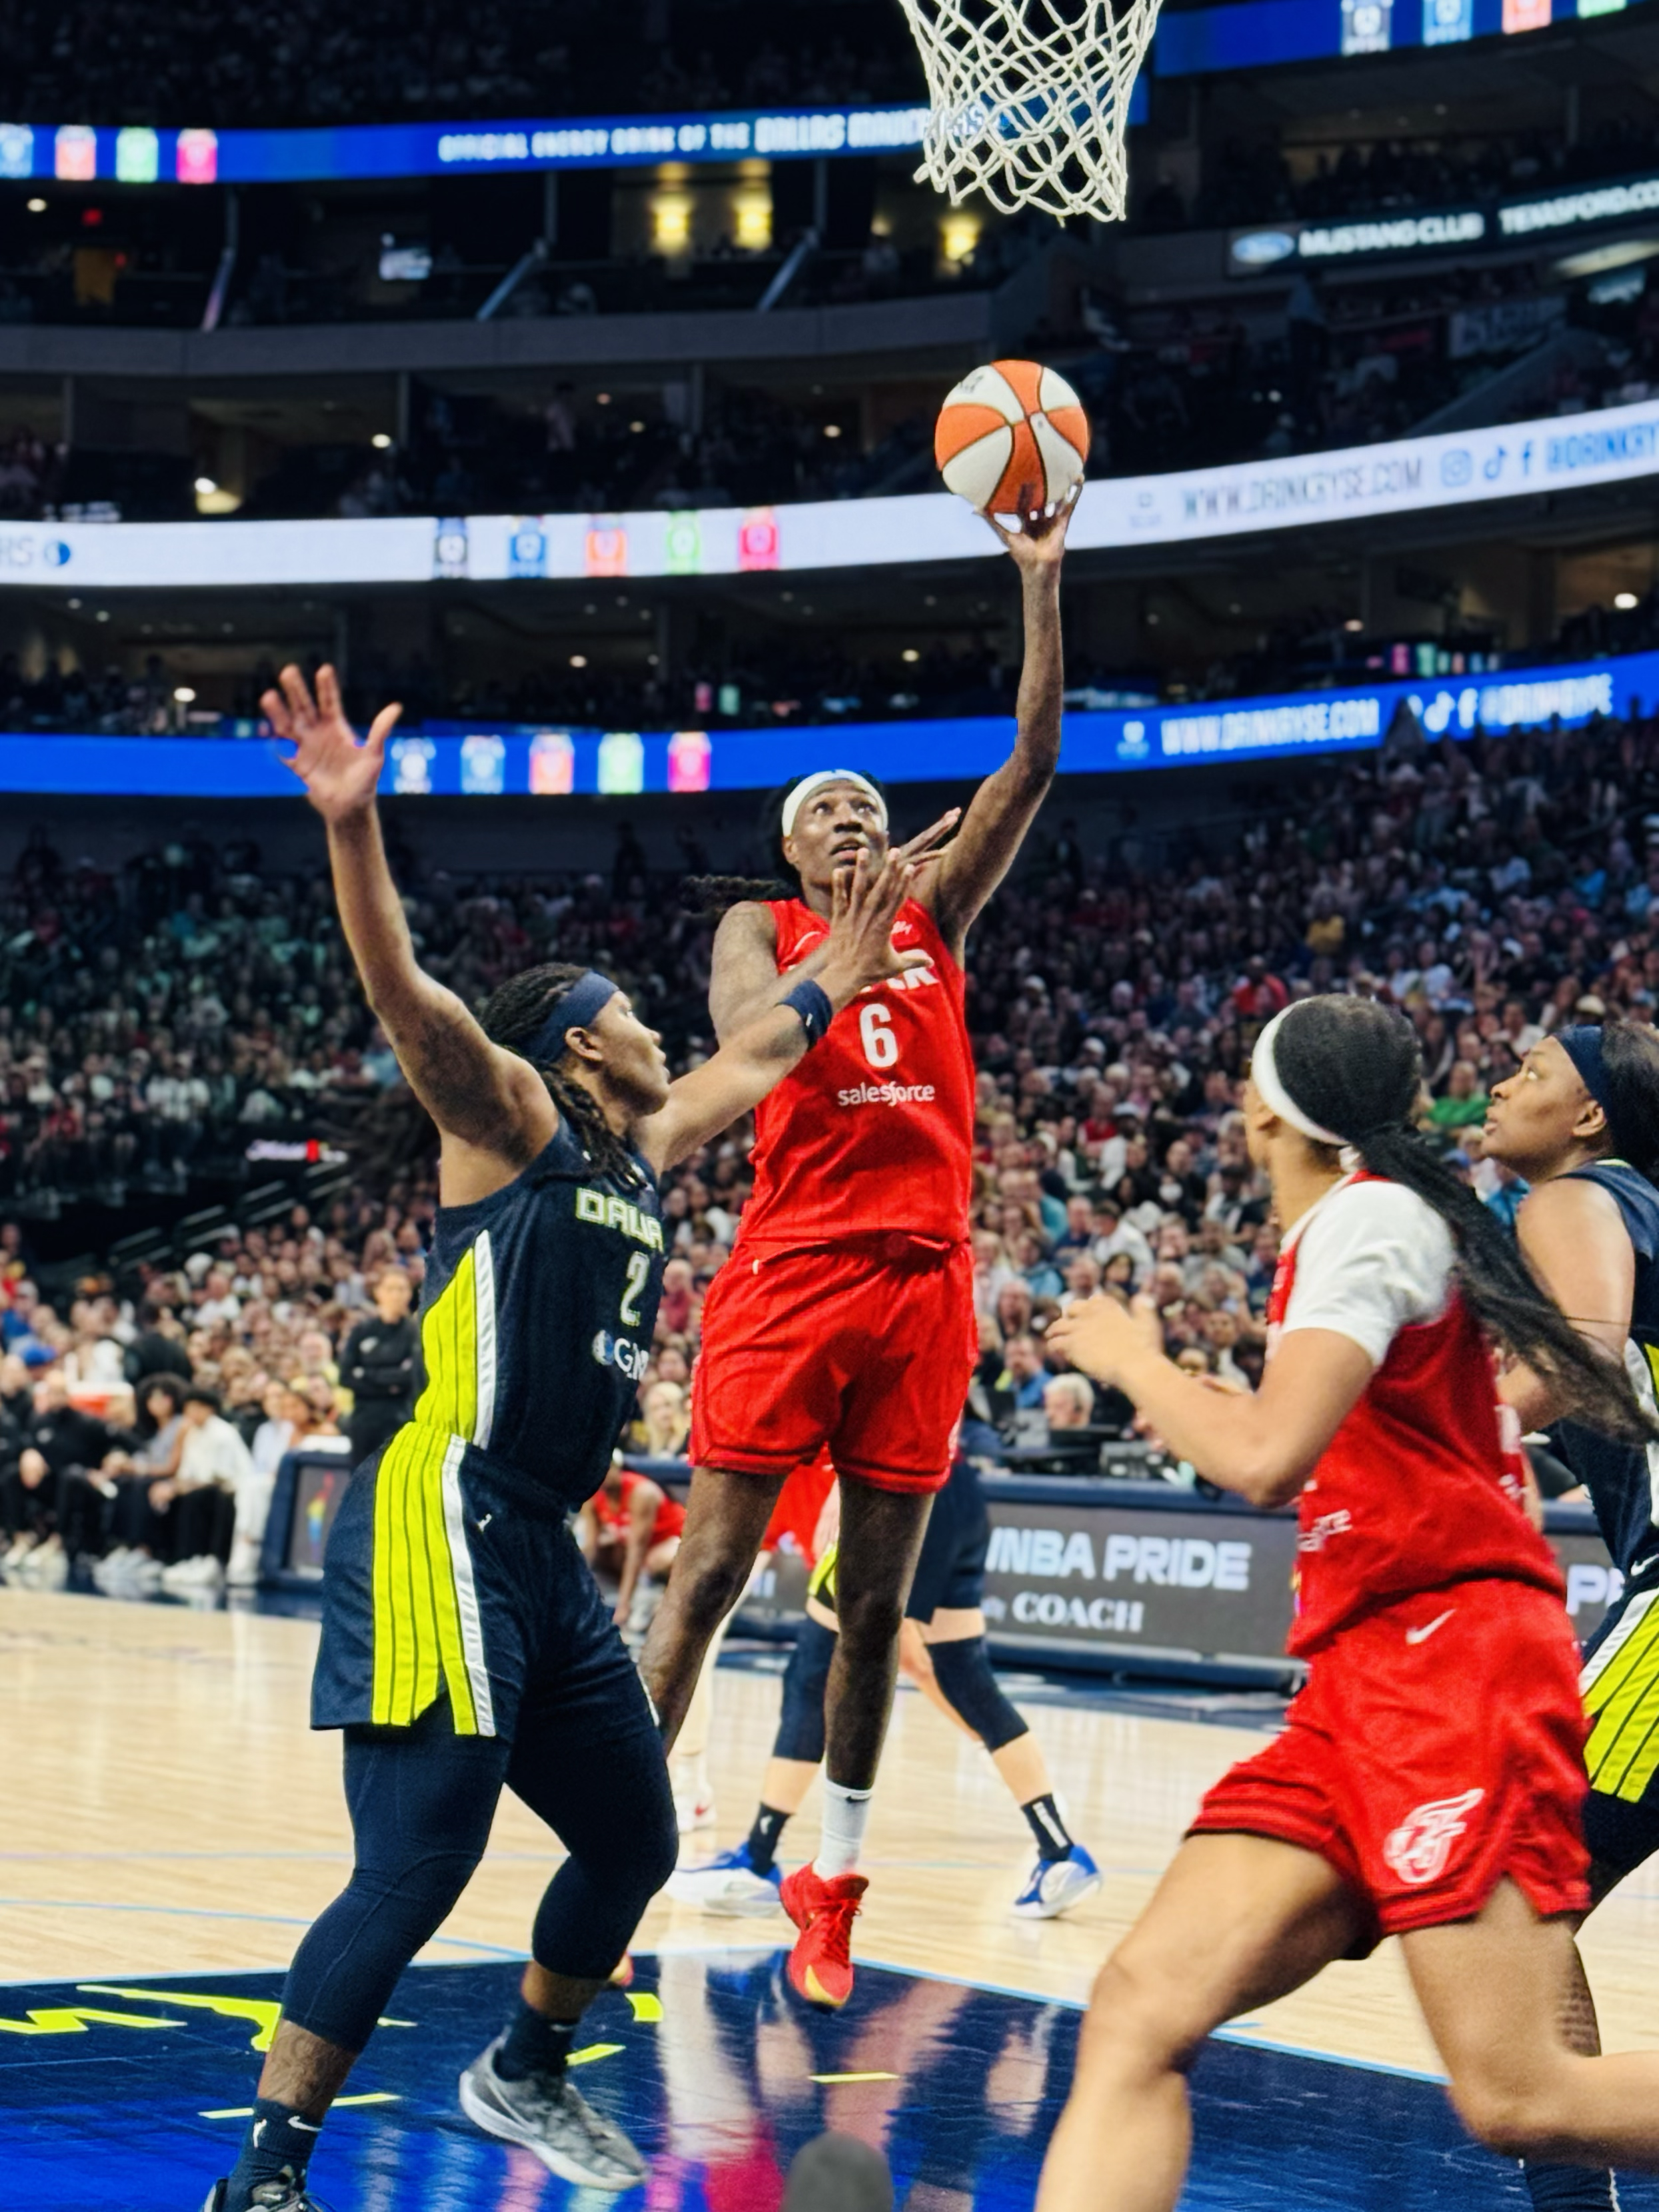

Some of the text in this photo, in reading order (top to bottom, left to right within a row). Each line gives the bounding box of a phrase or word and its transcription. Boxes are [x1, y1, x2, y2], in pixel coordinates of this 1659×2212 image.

[678, 124, 706, 151] OF
[710, 122, 750, 149] THE
[1299, 218, 1418, 256] MUSTANG
[1417, 212, 1485, 244] CLUB
[860, 1003, 898, 1068] 6
[837, 1081, 936, 1107] salesforce
[621, 1251, 651, 1327] 2
[984, 1527, 1096, 1580] NBA
[1102, 1534, 1252, 1591] PRIDE
[1012, 1591, 1144, 1633] COACH
